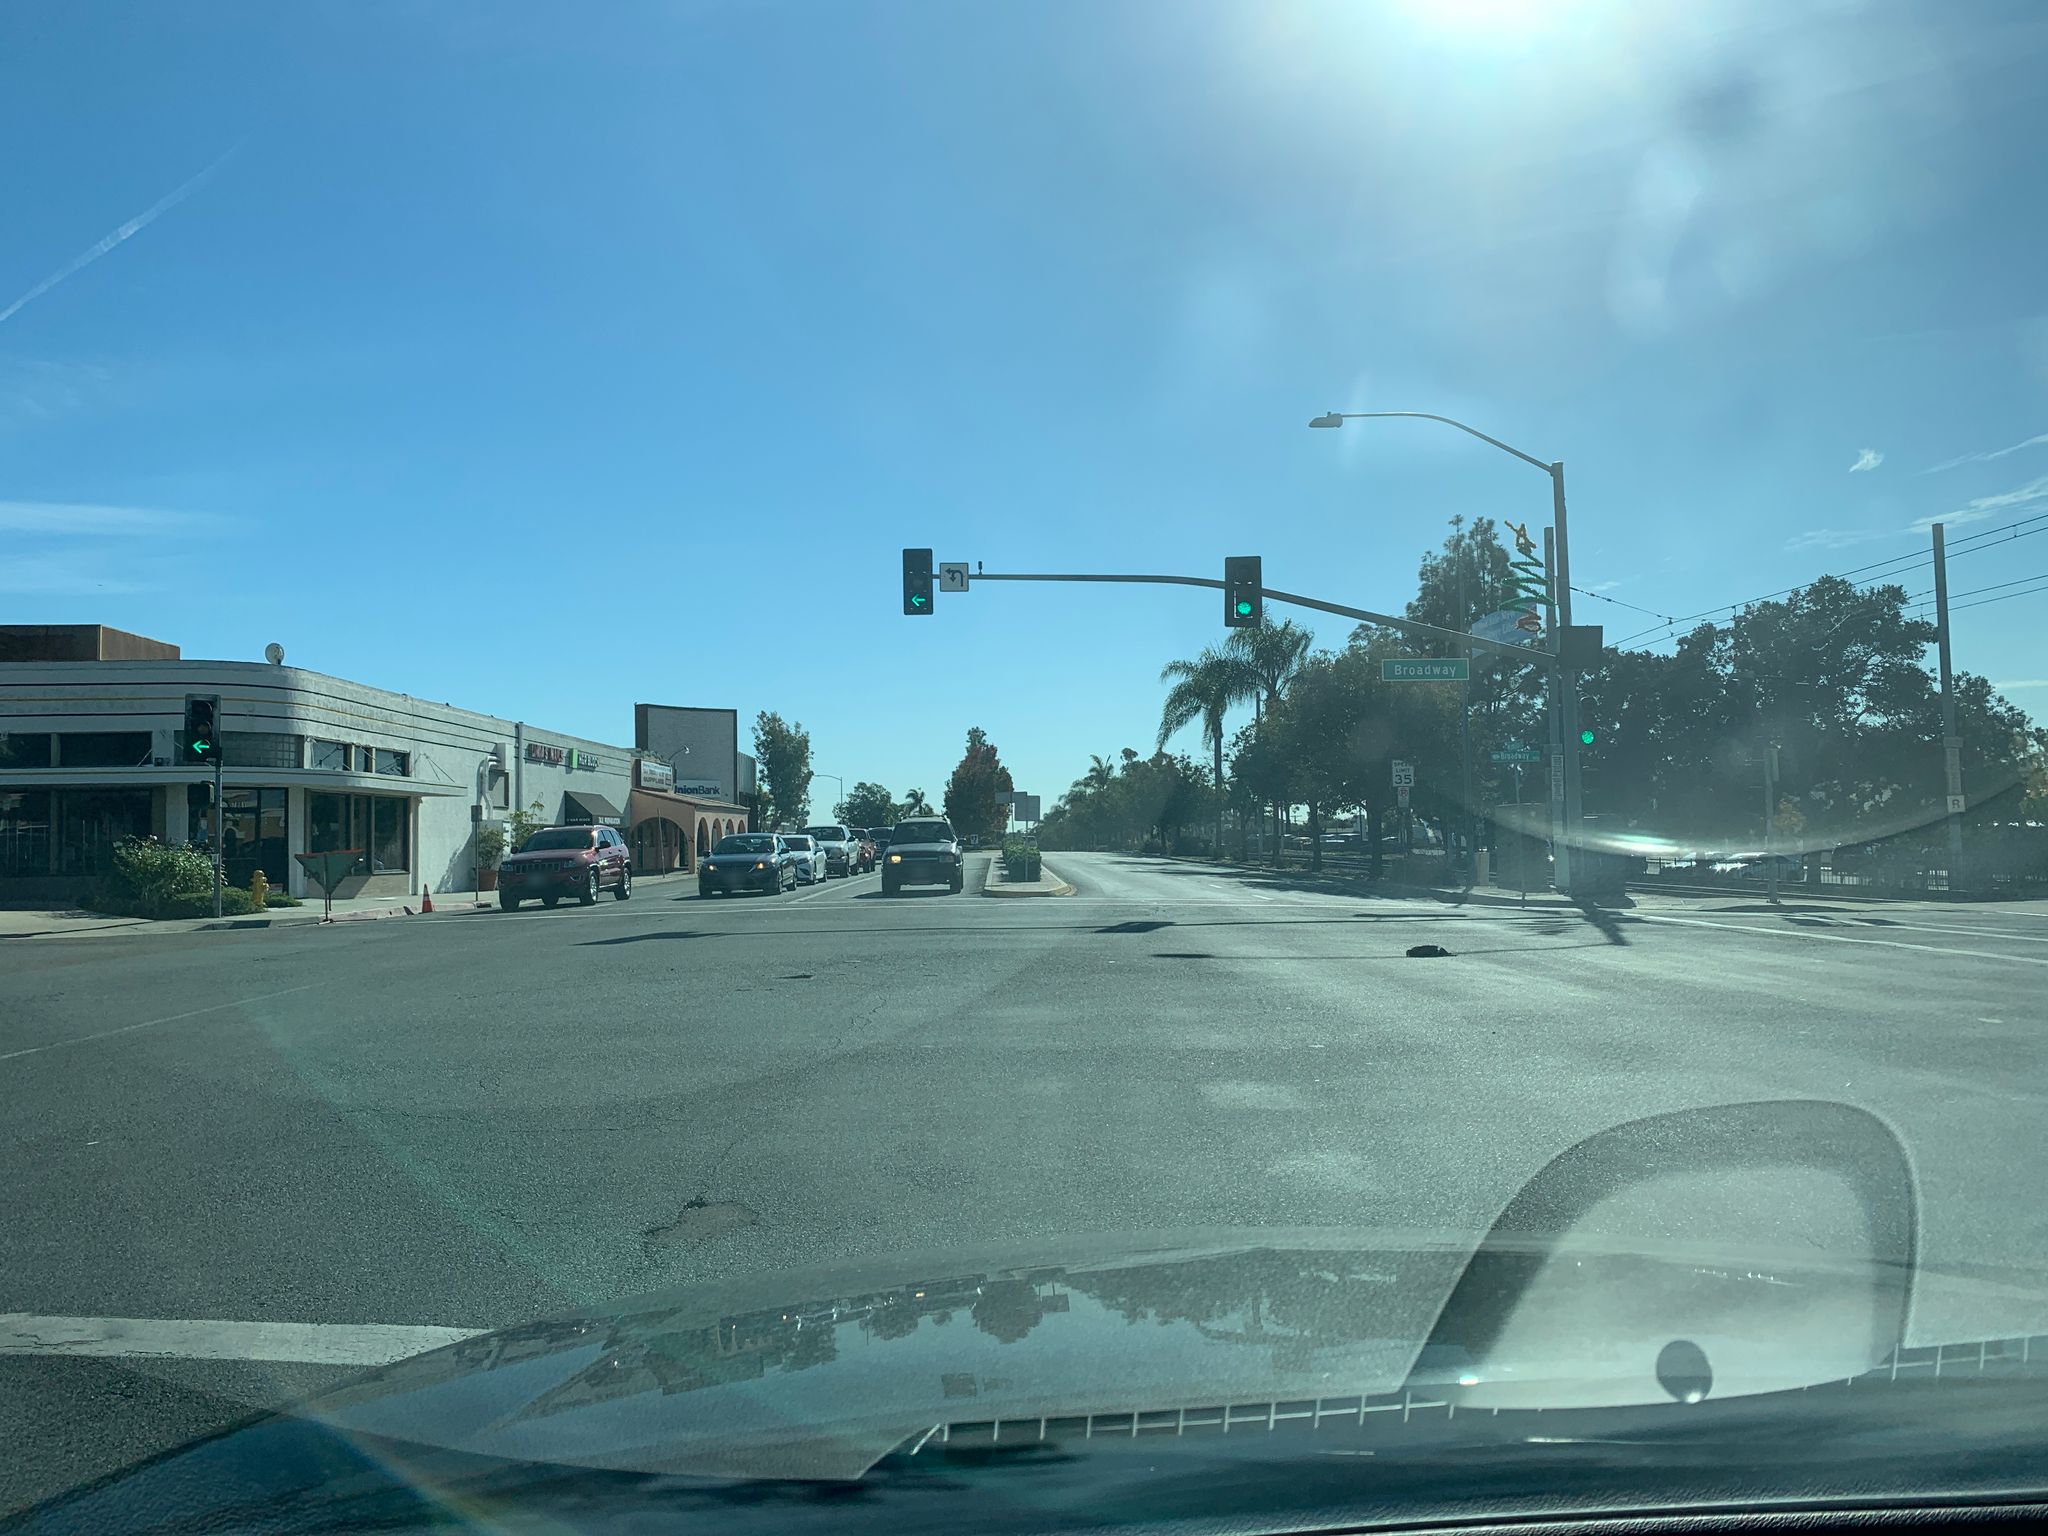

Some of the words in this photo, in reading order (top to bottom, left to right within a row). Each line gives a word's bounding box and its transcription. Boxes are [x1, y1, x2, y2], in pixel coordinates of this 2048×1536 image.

[1394, 664, 1456, 677] Broadway
[1501, 752, 1530, 760] Broadway
[1394, 774, 1412, 784] 35
